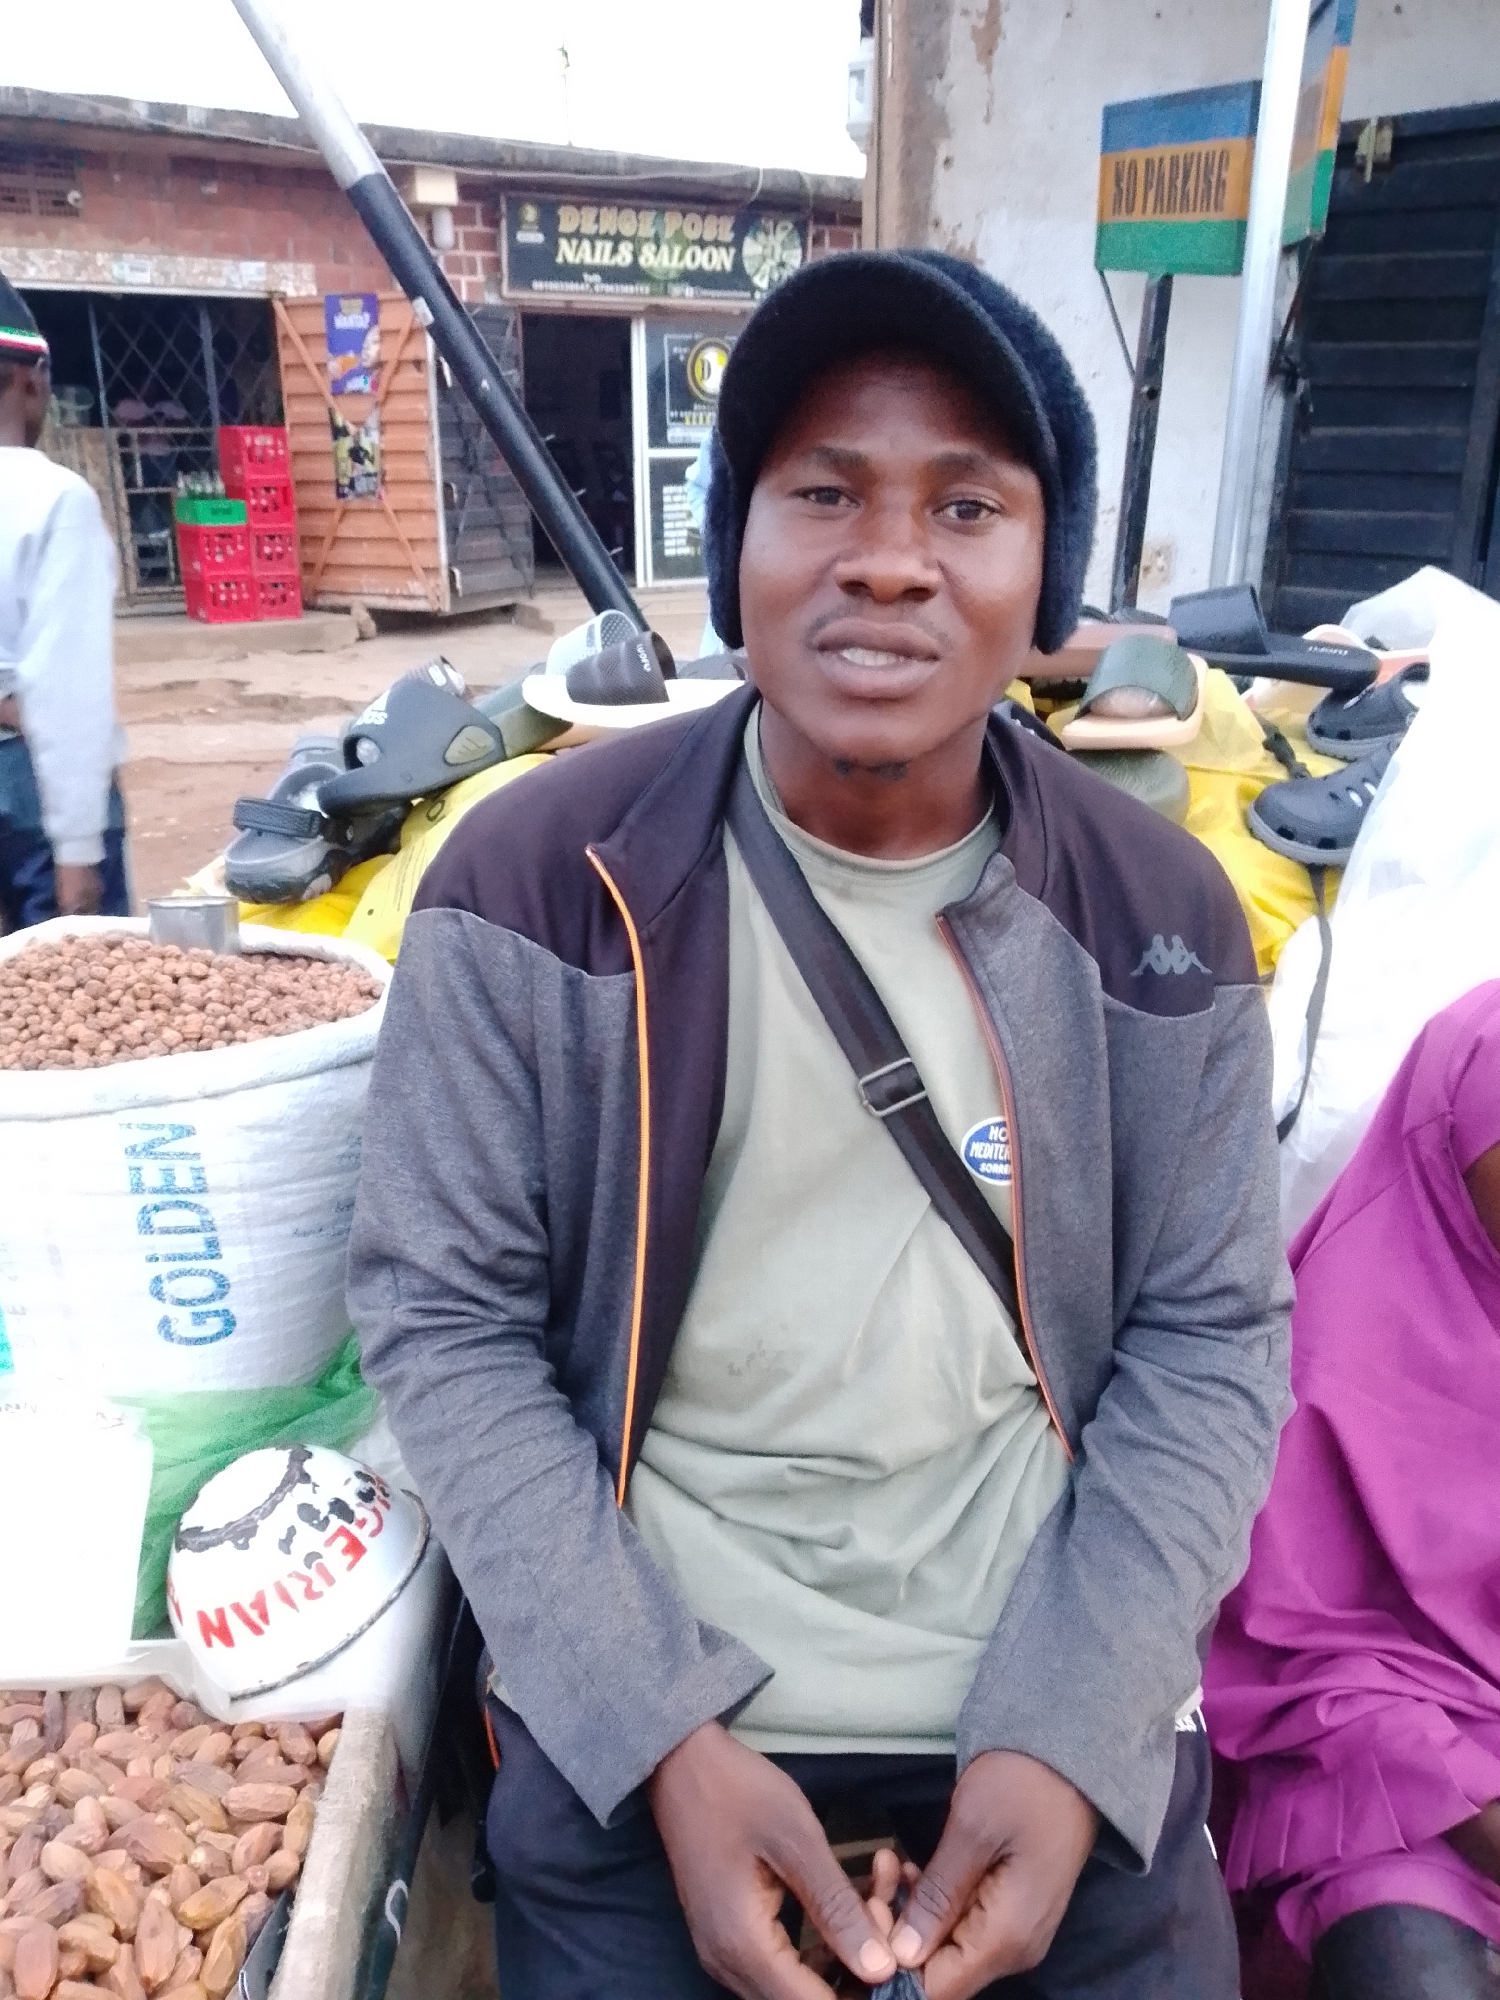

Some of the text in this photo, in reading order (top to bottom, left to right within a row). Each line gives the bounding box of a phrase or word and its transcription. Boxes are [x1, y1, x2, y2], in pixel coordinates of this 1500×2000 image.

[1112, 149, 1230, 216] NO PARKING
[555, 236, 736, 273] NAILS SALOON
[119, 1121, 238, 1347] GOLDEN
